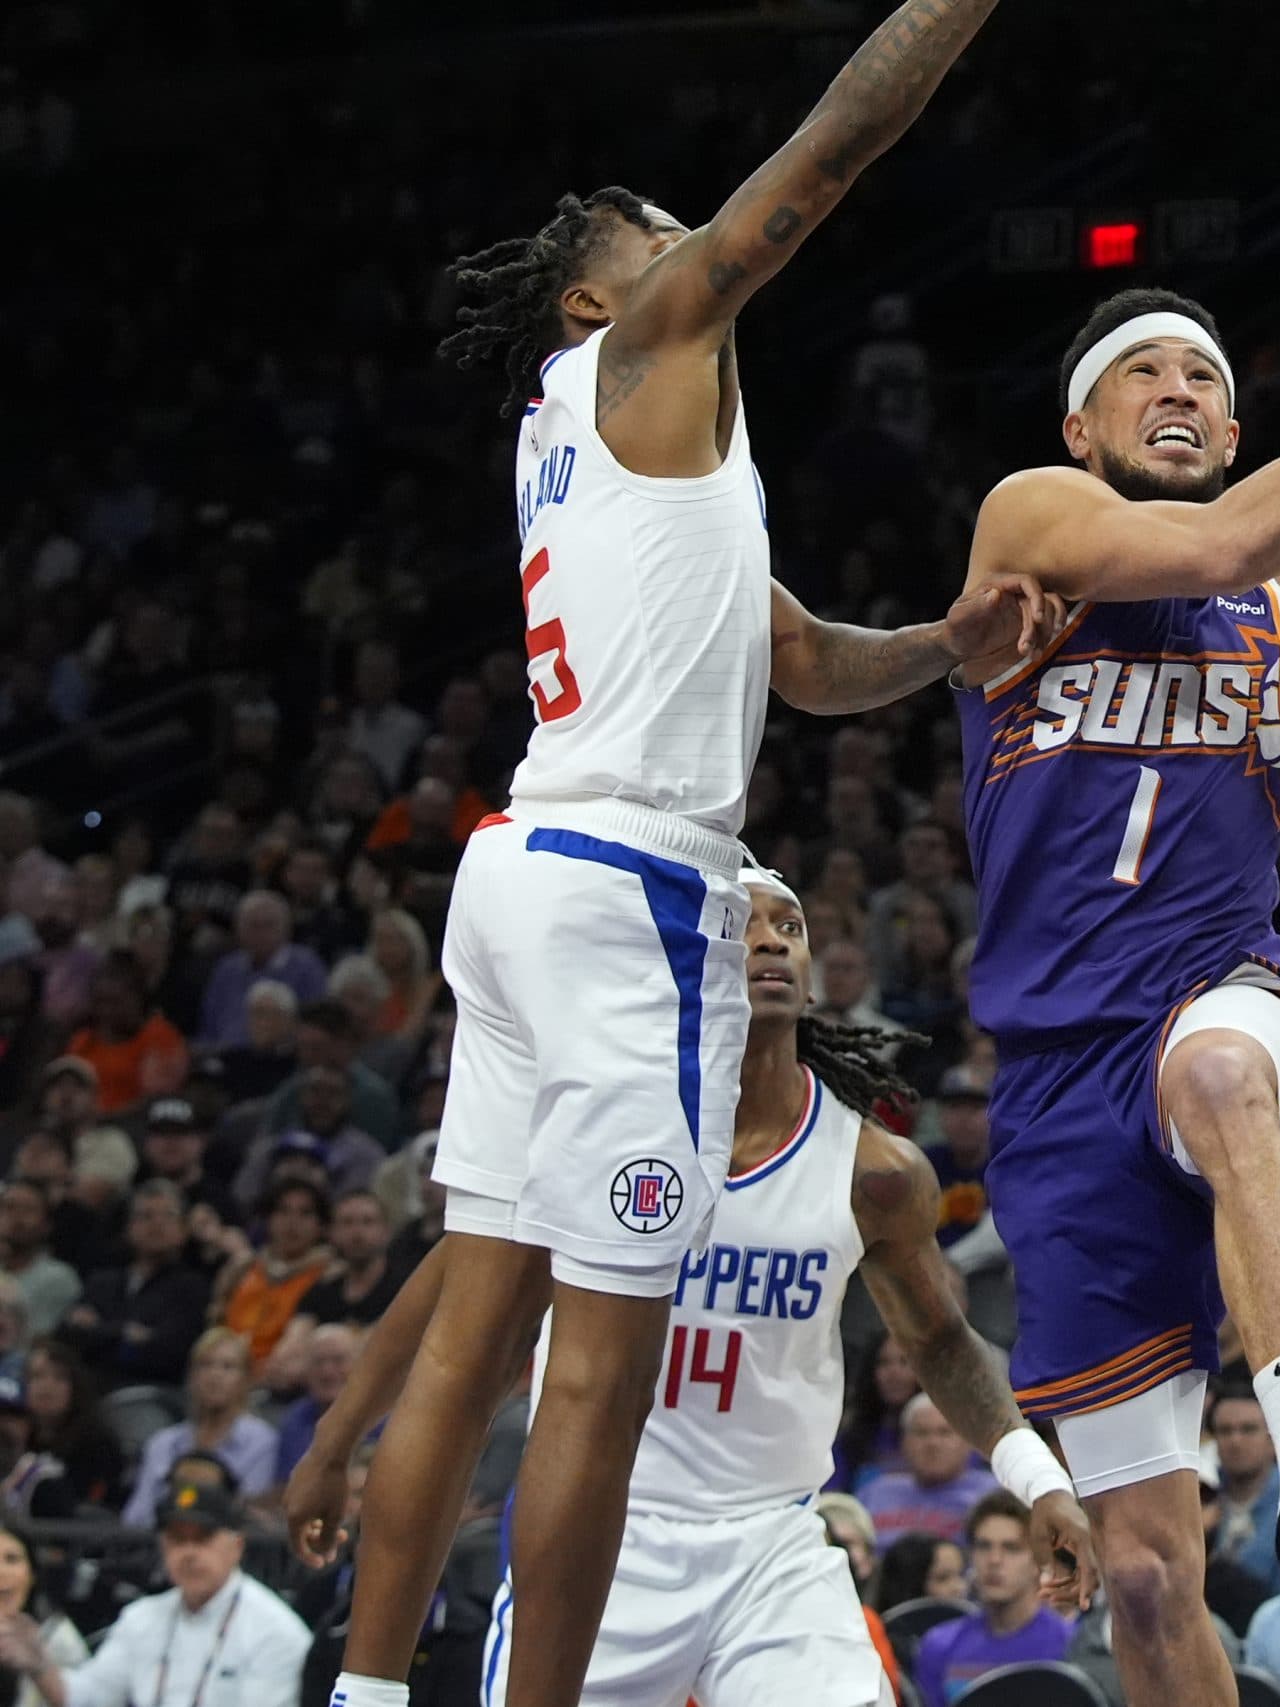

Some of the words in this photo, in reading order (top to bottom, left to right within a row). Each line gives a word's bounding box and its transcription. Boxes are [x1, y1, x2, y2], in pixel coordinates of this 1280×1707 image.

[522, 546, 582, 723] 5
[1216, 595, 1266, 615] PayPal
[1033, 659, 1252, 751] SUNS
[1111, 765, 1162, 885] 1
[664, 1325, 743, 1412] 14
